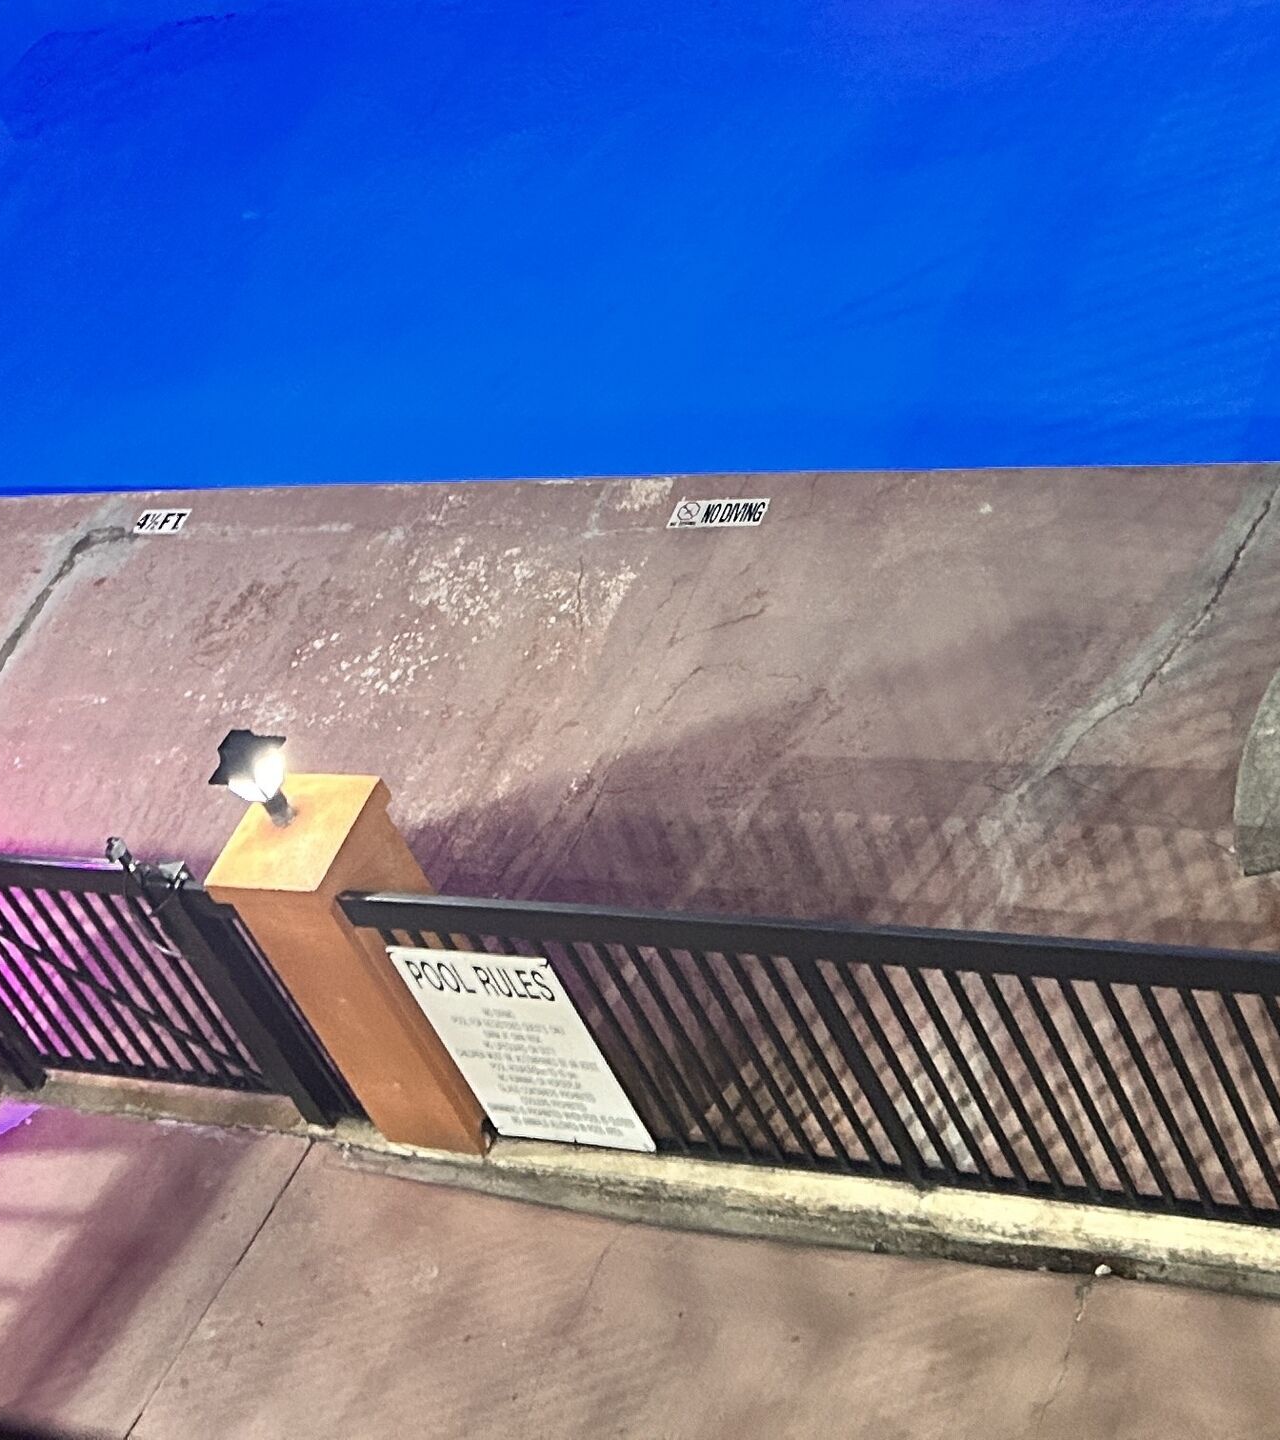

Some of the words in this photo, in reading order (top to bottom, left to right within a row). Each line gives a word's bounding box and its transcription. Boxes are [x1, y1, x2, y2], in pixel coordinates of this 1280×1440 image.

[158, 512, 187, 530] FT
[701, 503, 722, 524] NO
[719, 501, 766, 523] DIVING
[404, 960, 477, 994] POOL
[472, 965, 556, 1002] RULES
